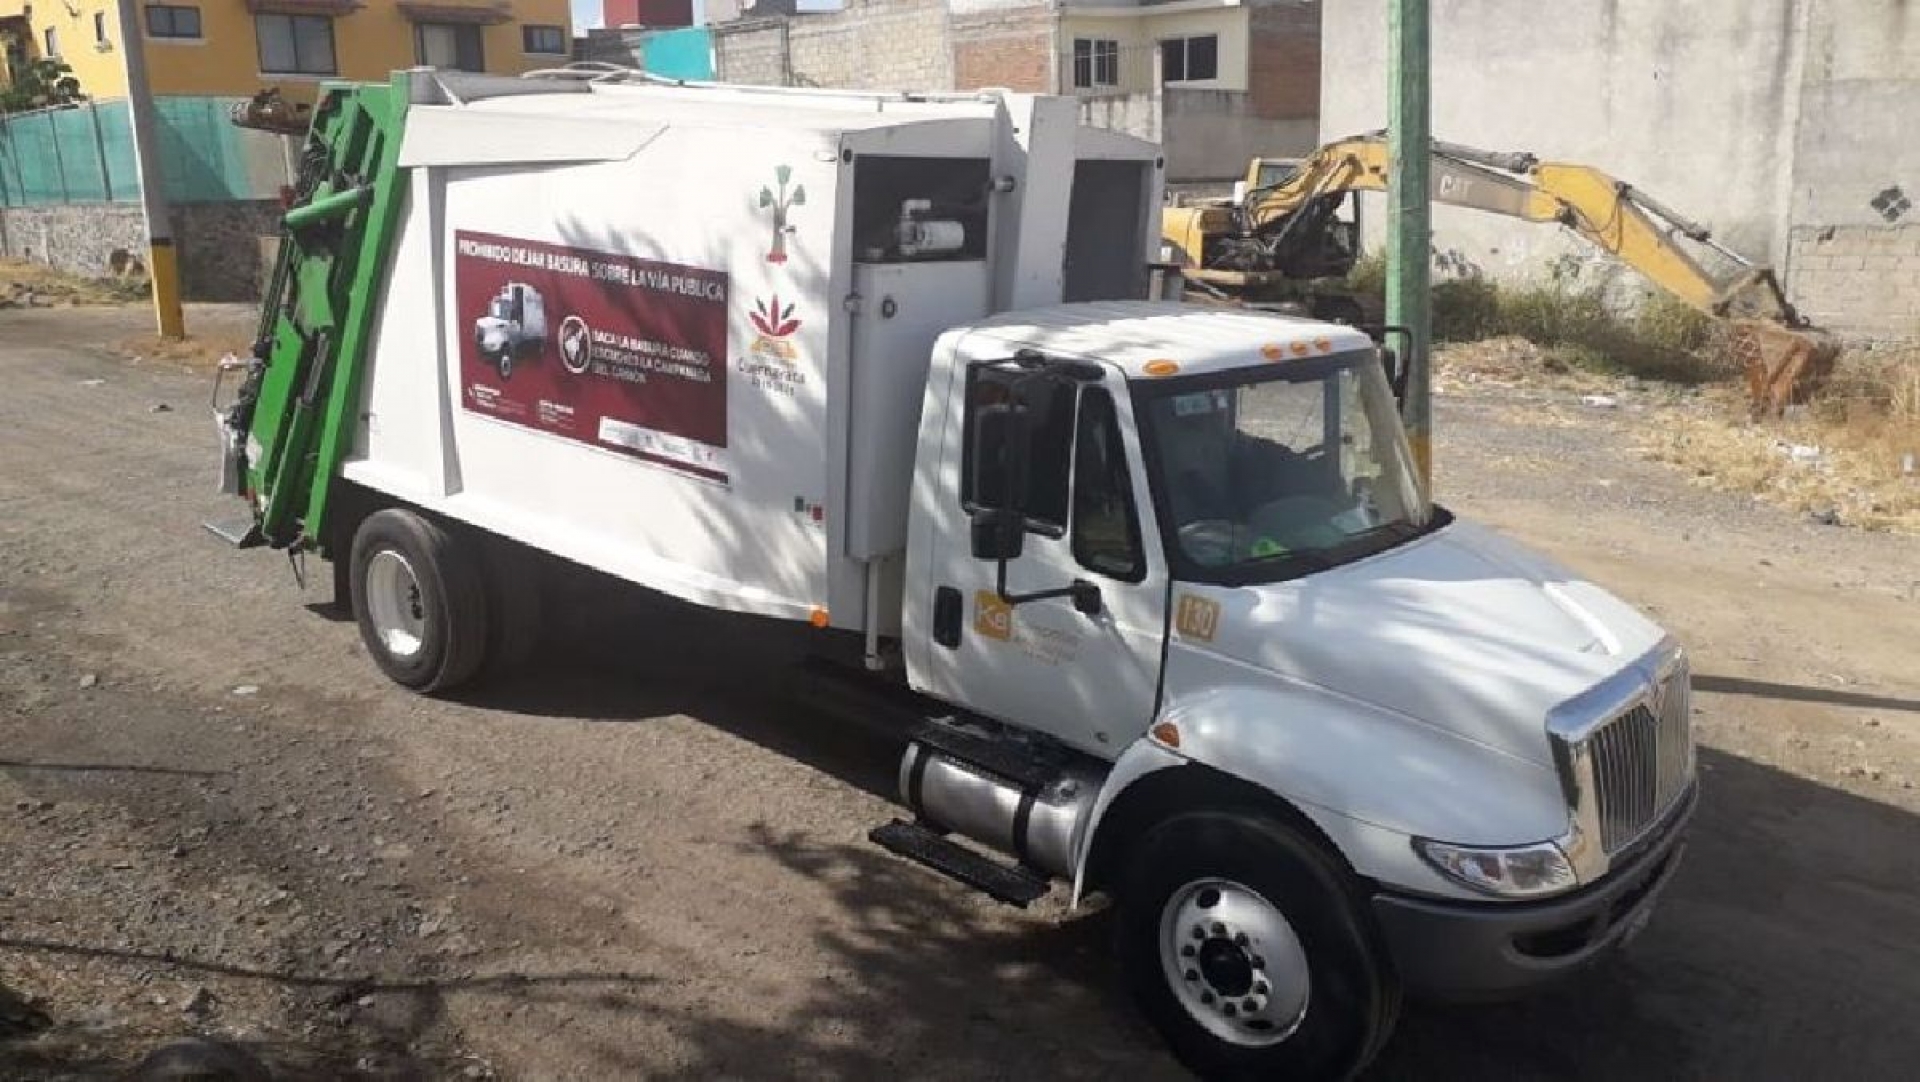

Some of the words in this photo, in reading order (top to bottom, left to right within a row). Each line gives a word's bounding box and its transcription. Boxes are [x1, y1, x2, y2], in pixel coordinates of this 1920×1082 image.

[1440, 175, 1473, 199] CAT
[458, 239, 510, 262] PROHIBIDO
[511, 246, 545, 269] DEJAR
[547, 252, 590, 276] BASURA
[591, 262, 630, 286] SOBRE
[631, 268, 646, 289] LA
[617, 334, 630, 349] LA
[1182, 599, 1214, 635] 130
